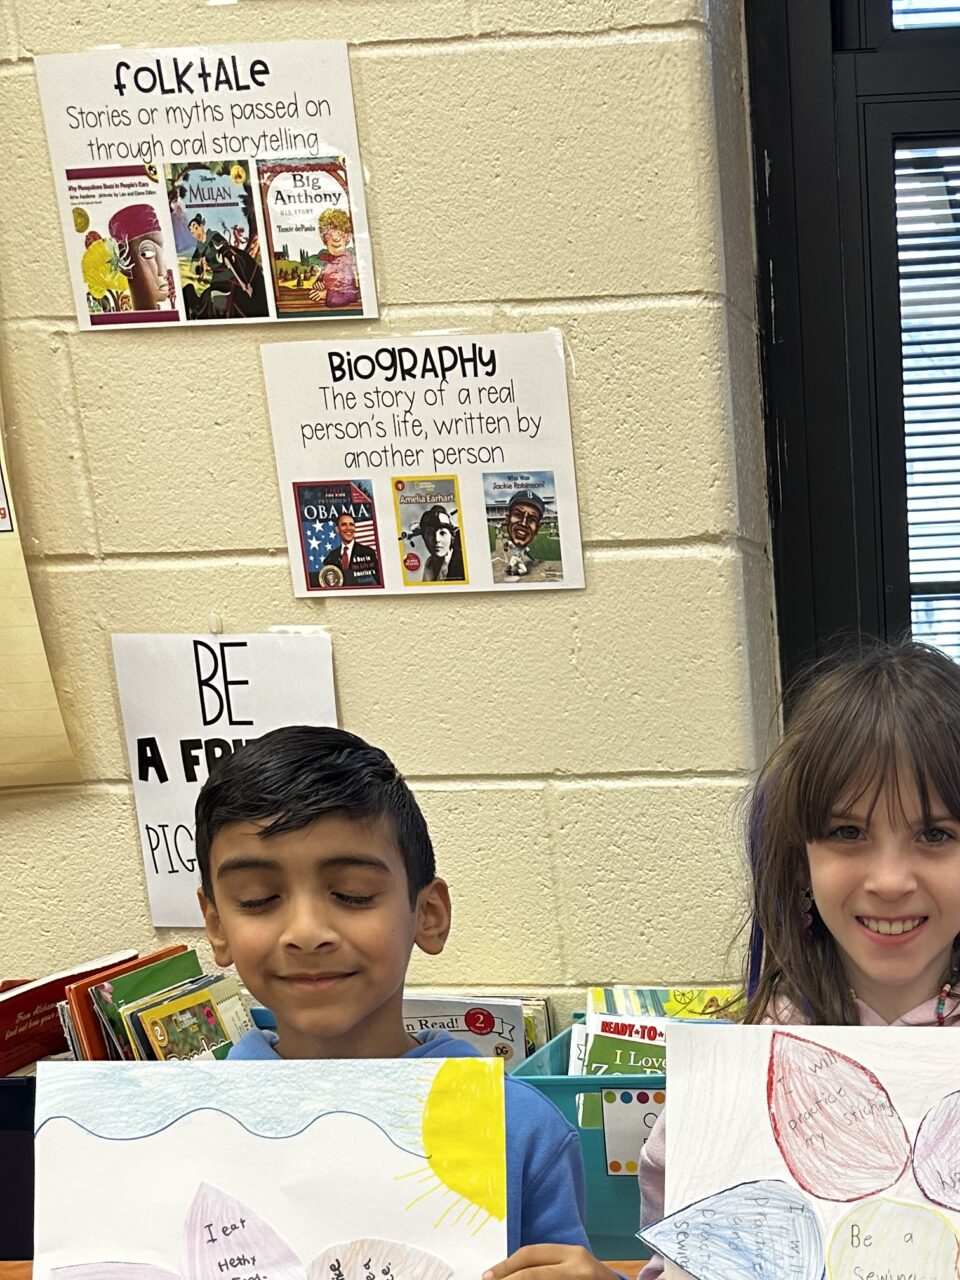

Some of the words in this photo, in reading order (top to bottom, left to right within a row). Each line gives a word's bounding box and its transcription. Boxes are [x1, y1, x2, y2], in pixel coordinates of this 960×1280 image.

[66, 105, 131, 129] Stories
[138, 107, 158, 125] or
[166, 99, 224, 129] myths
[230, 92, 298, 128] passed
[305, 97, 331, 117] on
[87, 134, 164, 163] through
[171, 131, 207, 156] oral
[212, 127, 319, 156] storytelling
[292, 173, 320, 191] Big
[189, 184, 232, 203] MULAN
[274, 190, 342, 206] Anthony
[318, 386, 357, 411] The
[363, 386, 415, 412] story
[424, 379, 449, 406] of
[458, 387, 471, 405] a
[478, 379, 515, 404] real
[300, 414, 387, 448] person's
[392, 410, 429, 440] life,
[433, 411, 511, 436] written
[516, 407, 542, 439] by
[344, 444, 424, 469] another
[432, 445, 505, 473] person
[493, 482, 512, 490] Jackie
[513, 480, 546, 489] Robinson?
[400, 494, 426, 504] Amelia
[426, 493, 455, 503] Earhart
[304, 504, 371, 520] OBAMA
[193, 639, 254, 726] BE
[137, 737, 169, 783] A
[418, 1018, 460, 1030] Read!
[475, 1014, 485, 1027] 2
[153, 1025, 165, 1040] 2
[614, 1049, 622, 1064] I
[808, 1051, 838, 1074] will
[788, 1088, 847, 1137] practice
[805, 1133, 828, 1151] my
[789, 1204, 805, 1214] I
[204, 1224, 217, 1244] I
[221, 1217, 246, 1237] eat
[850, 1224, 872, 1248] Be
[903, 1232, 914, 1243] a
[363, 1257, 372, 1270] a
[789, 1240, 804, 1273] will
